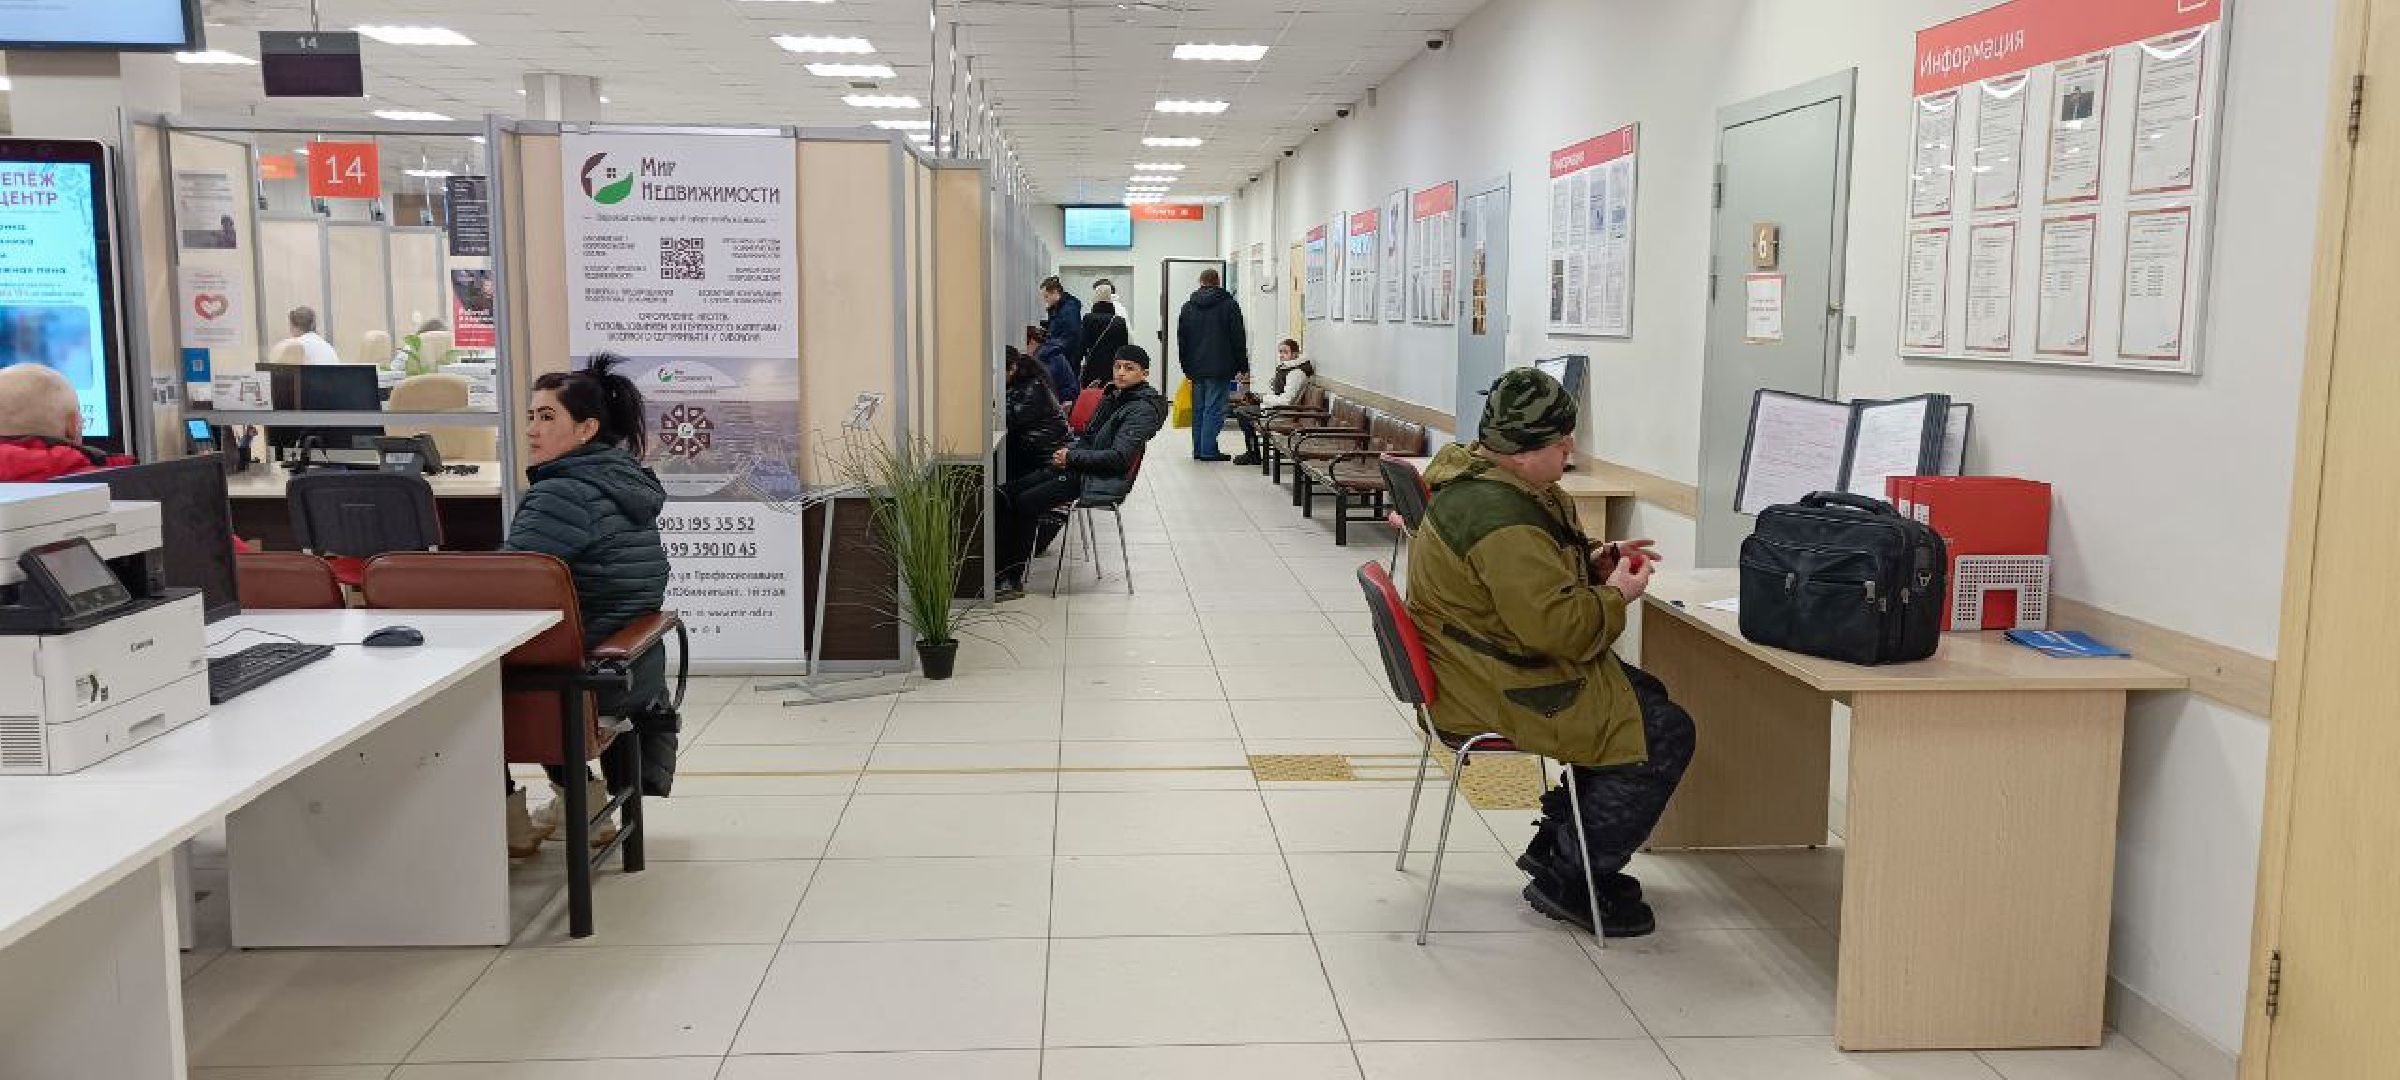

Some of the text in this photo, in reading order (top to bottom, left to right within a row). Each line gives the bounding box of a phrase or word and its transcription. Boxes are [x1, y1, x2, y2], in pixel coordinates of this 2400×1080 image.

[297, 37, 317, 48] 14
[1920, 29, 2025, 78] Информация
[325, 154, 367, 184] 14
[657, 516, 756, 531] 903 195 35 52
[692, 542, 719, 556] 390
[722, 542, 736, 556] 10
[739, 542, 758, 556] 45
